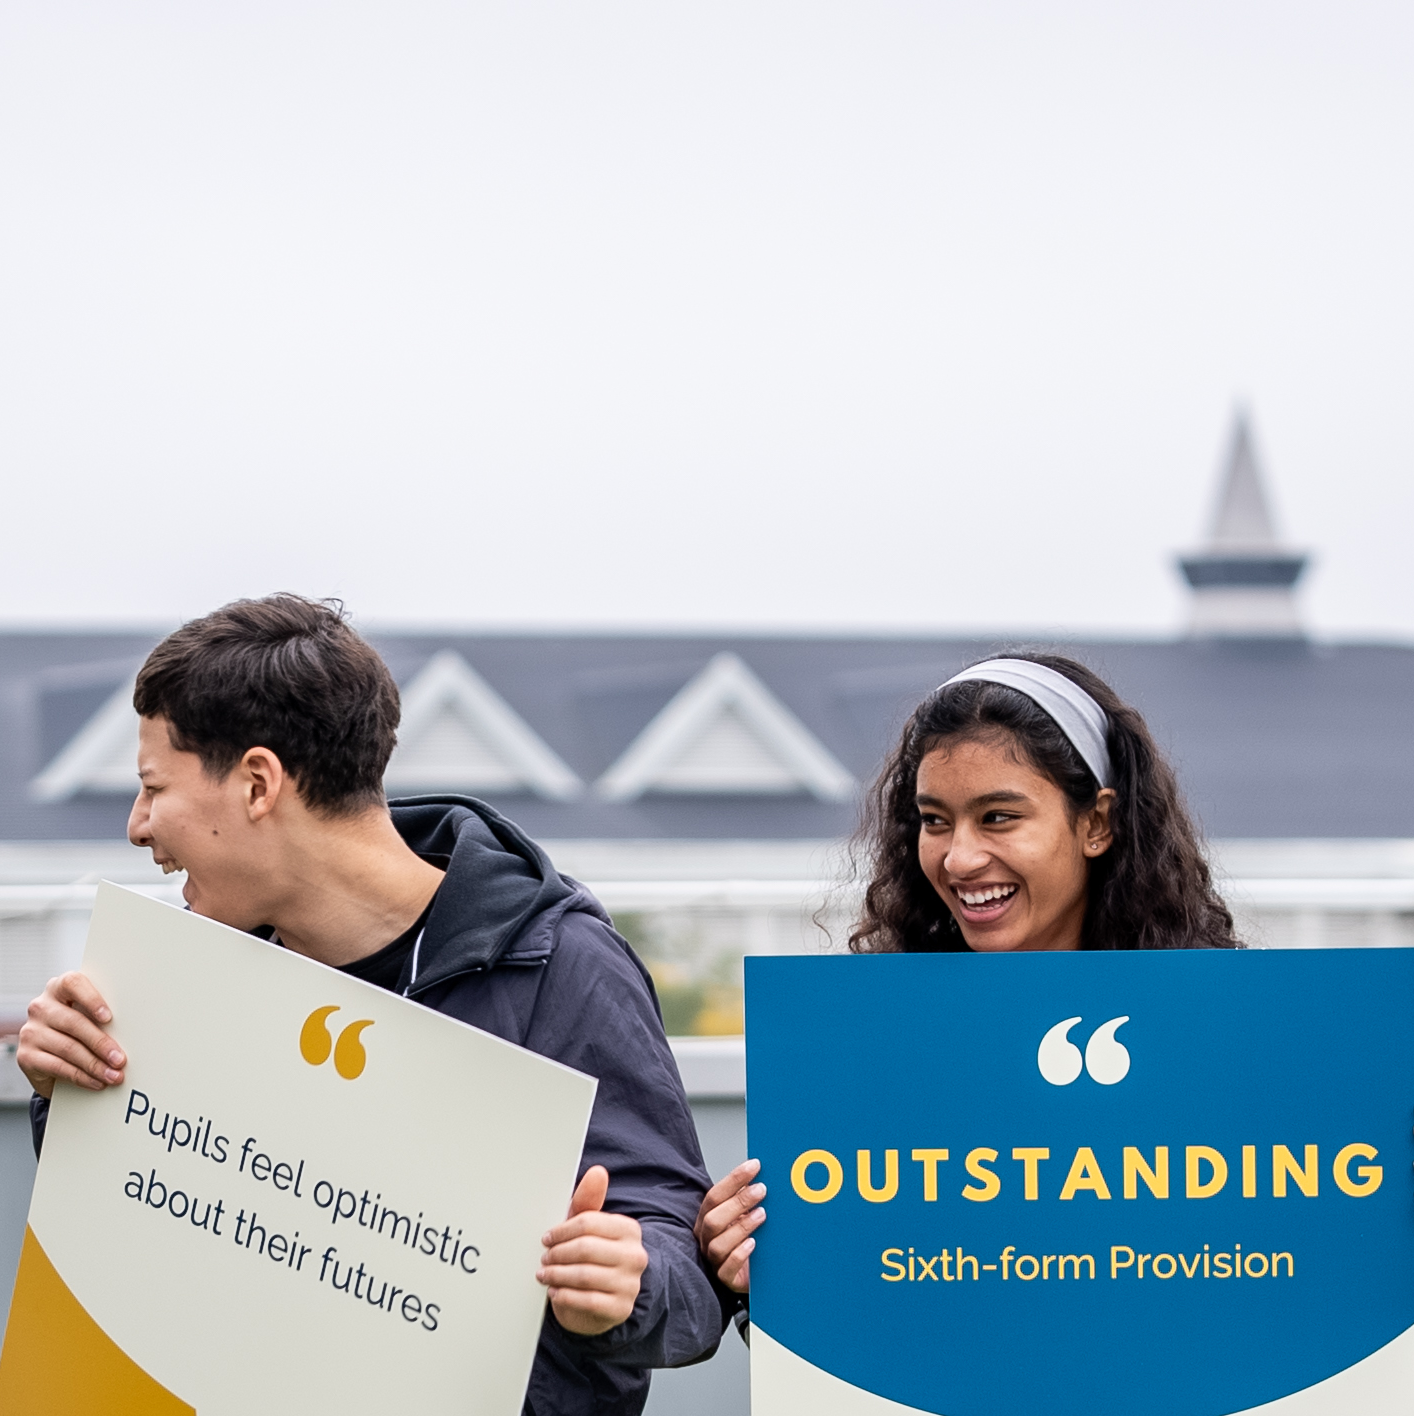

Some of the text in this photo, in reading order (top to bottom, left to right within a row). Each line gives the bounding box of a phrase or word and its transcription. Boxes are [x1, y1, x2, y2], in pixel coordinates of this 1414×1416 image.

[124, 1088, 481, 1274] Pupils feel optimistic
[790, 1142, 1384, 1204] OUTSTANDING
[124, 1168, 441, 1332] about their futures
[880, 1243, 1294, 1282] Sixth-form Provision
